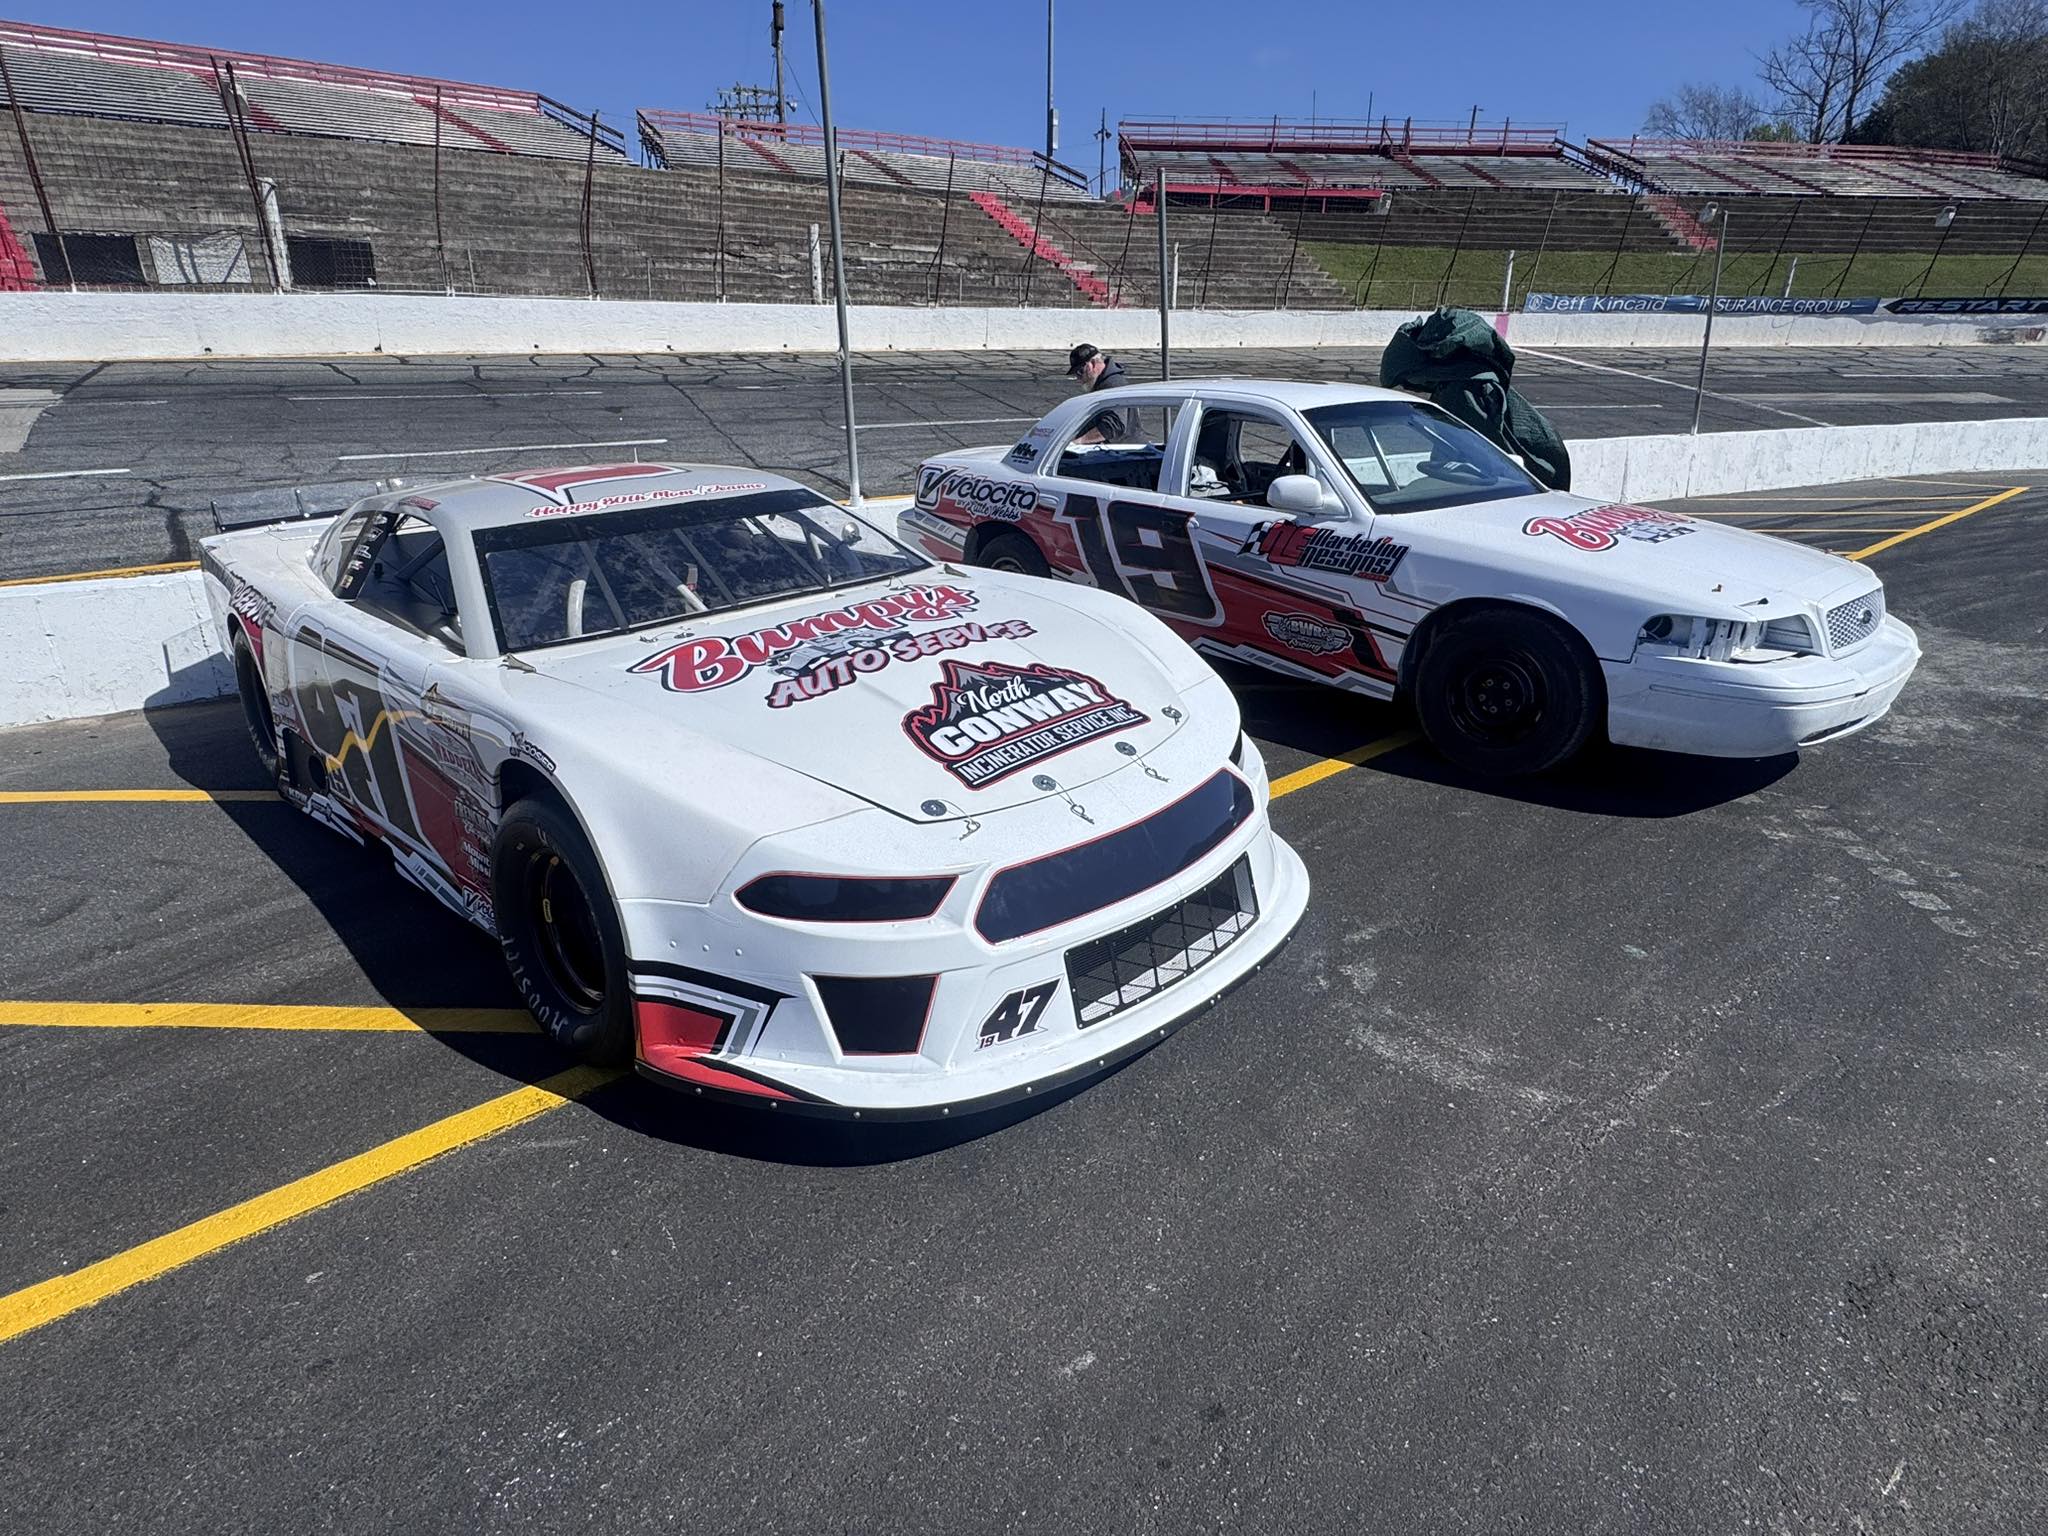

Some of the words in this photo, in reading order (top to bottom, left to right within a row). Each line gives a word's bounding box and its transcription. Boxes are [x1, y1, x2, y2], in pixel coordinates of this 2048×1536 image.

[1545, 297, 1586, 310] Jeff
[1592, 297, 1668, 311] Kincaid
[1698, 297, 1790, 312] INSURANCE
[1793, 299, 1851, 313] GROUP
[1897, 300, 2048, 311] RESTART
[533, 502, 599, 517] Happy
[652, 488, 695, 501] Mom
[1310, 528, 1409, 560] Marketing
[1299, 547, 1389, 576] Designs
[628, 585, 978, 692] Bumpy's
[1291, 620, 1322, 638] BWR
[767, 650, 889, 707] AUTO
[894, 620, 1036, 661] SERVICE
[958, 675, 1031, 713] North
[930, 682, 1105, 756] CONWAY
[958, 731, 1058, 781] INCINERATOR
[1055, 712, 1113, 742] SERVICE
[1109, 706, 1139, 725] INC.
[979, 978, 1061, 1043] 47
[979, 1036, 995, 1049] 19
